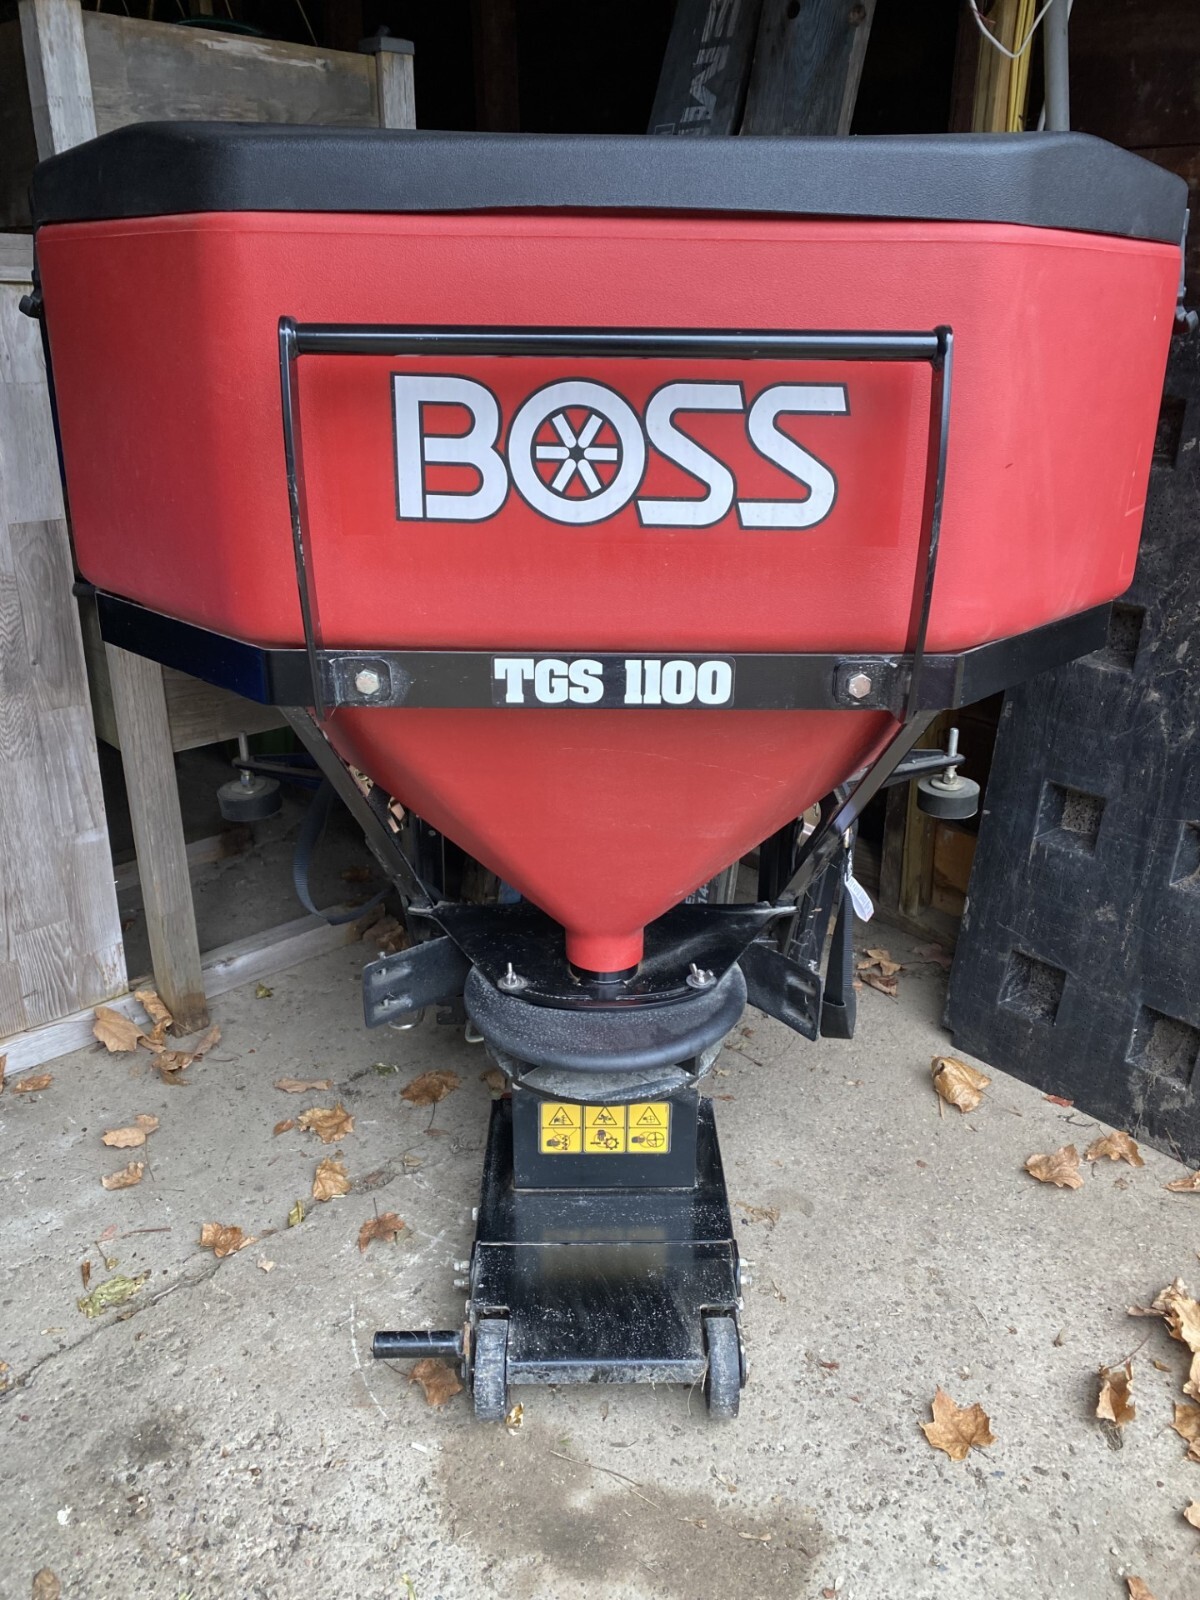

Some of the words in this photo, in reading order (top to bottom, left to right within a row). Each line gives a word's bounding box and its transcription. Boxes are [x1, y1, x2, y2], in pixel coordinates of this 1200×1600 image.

[391, 372, 849, 530] BOSS
[494, 658, 604, 703] TGS
[624, 659, 732, 704] 1100
